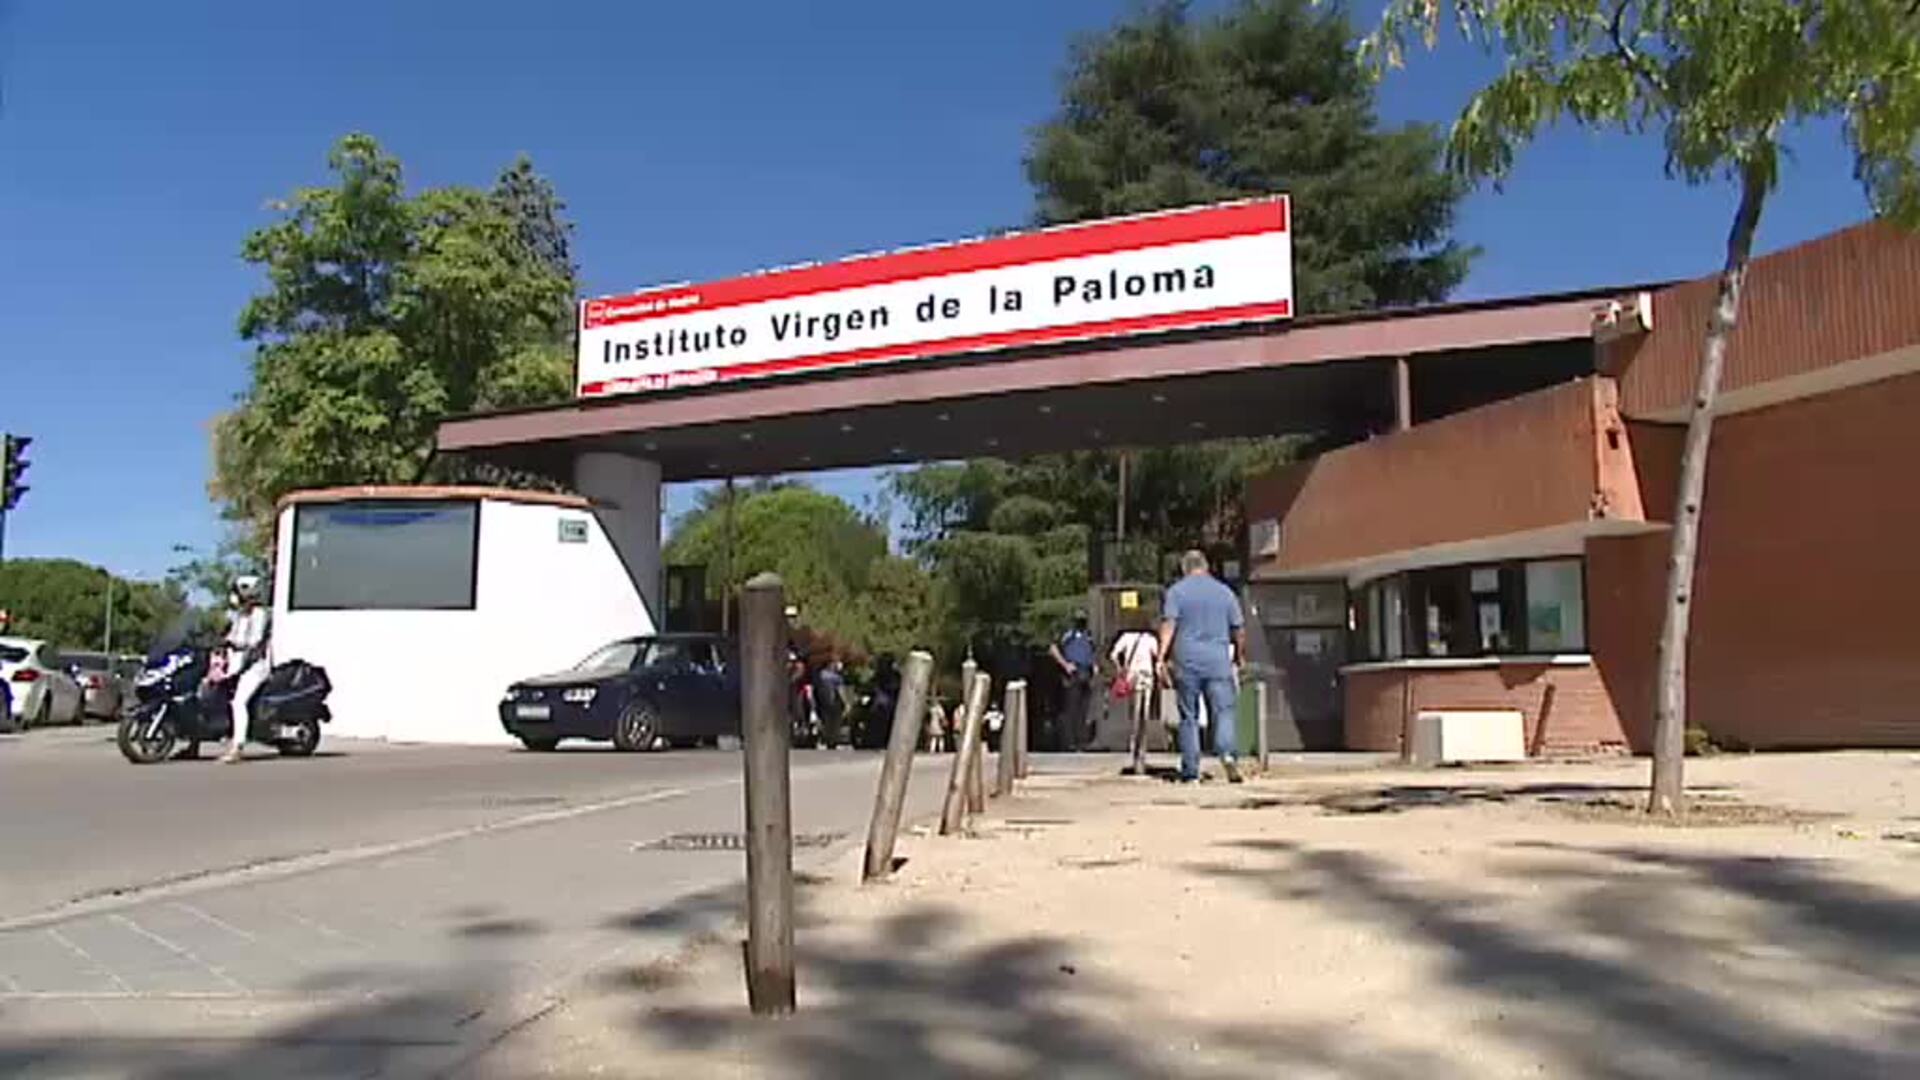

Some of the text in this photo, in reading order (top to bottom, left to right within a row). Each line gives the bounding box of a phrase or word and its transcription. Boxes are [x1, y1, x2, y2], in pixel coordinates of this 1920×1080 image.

[602, 264, 1215, 364] Instituto Virgen de la Paloma
